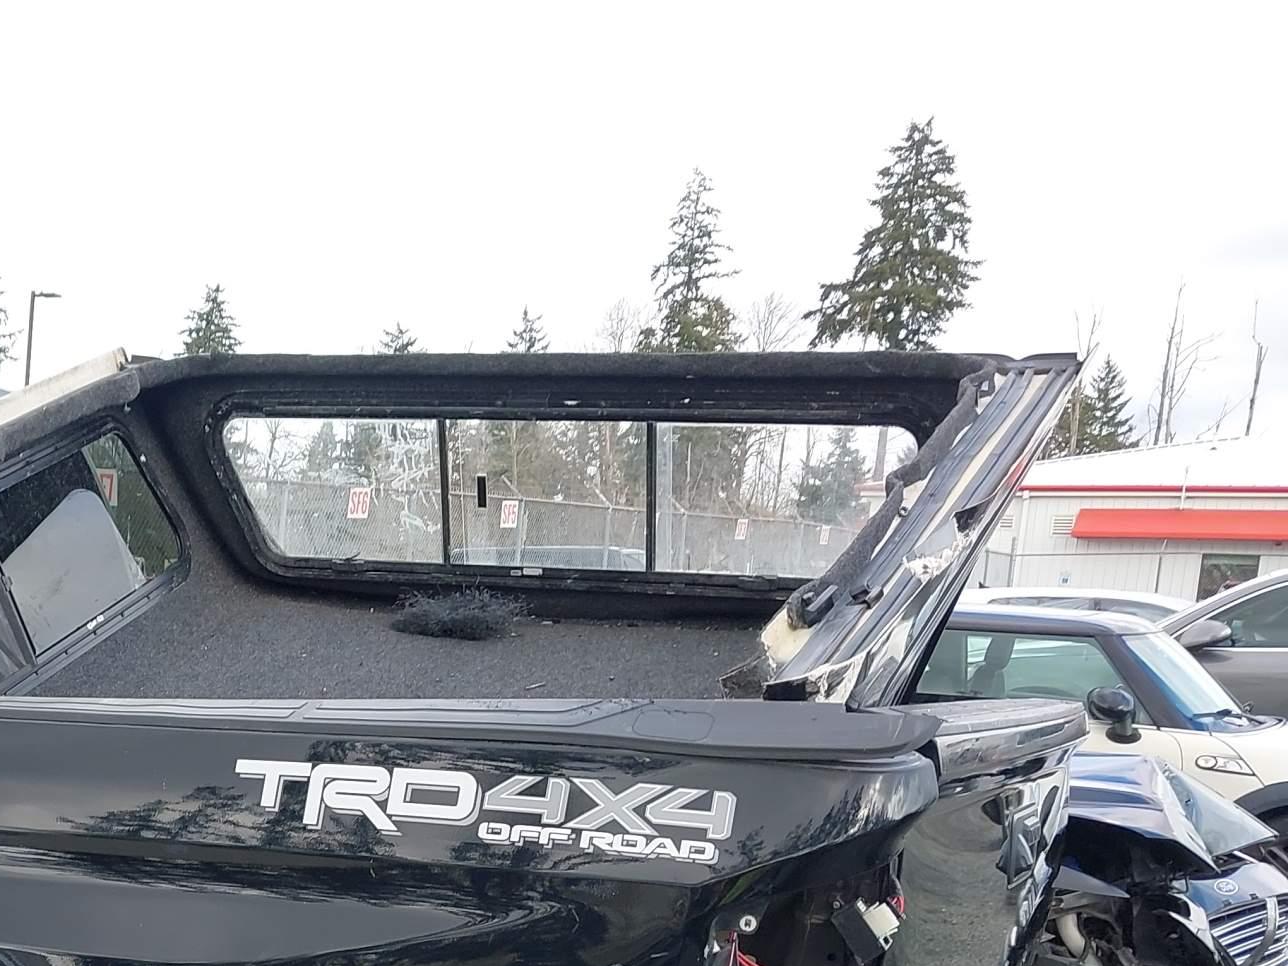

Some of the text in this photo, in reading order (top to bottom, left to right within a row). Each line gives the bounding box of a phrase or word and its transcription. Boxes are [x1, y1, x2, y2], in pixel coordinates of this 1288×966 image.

[349, 490, 369, 515] SF6
[502, 503, 517, 525] SF5
[234, 759, 738, 840] TRD 4X4
[476, 821, 720, 864] OFF ROAD
